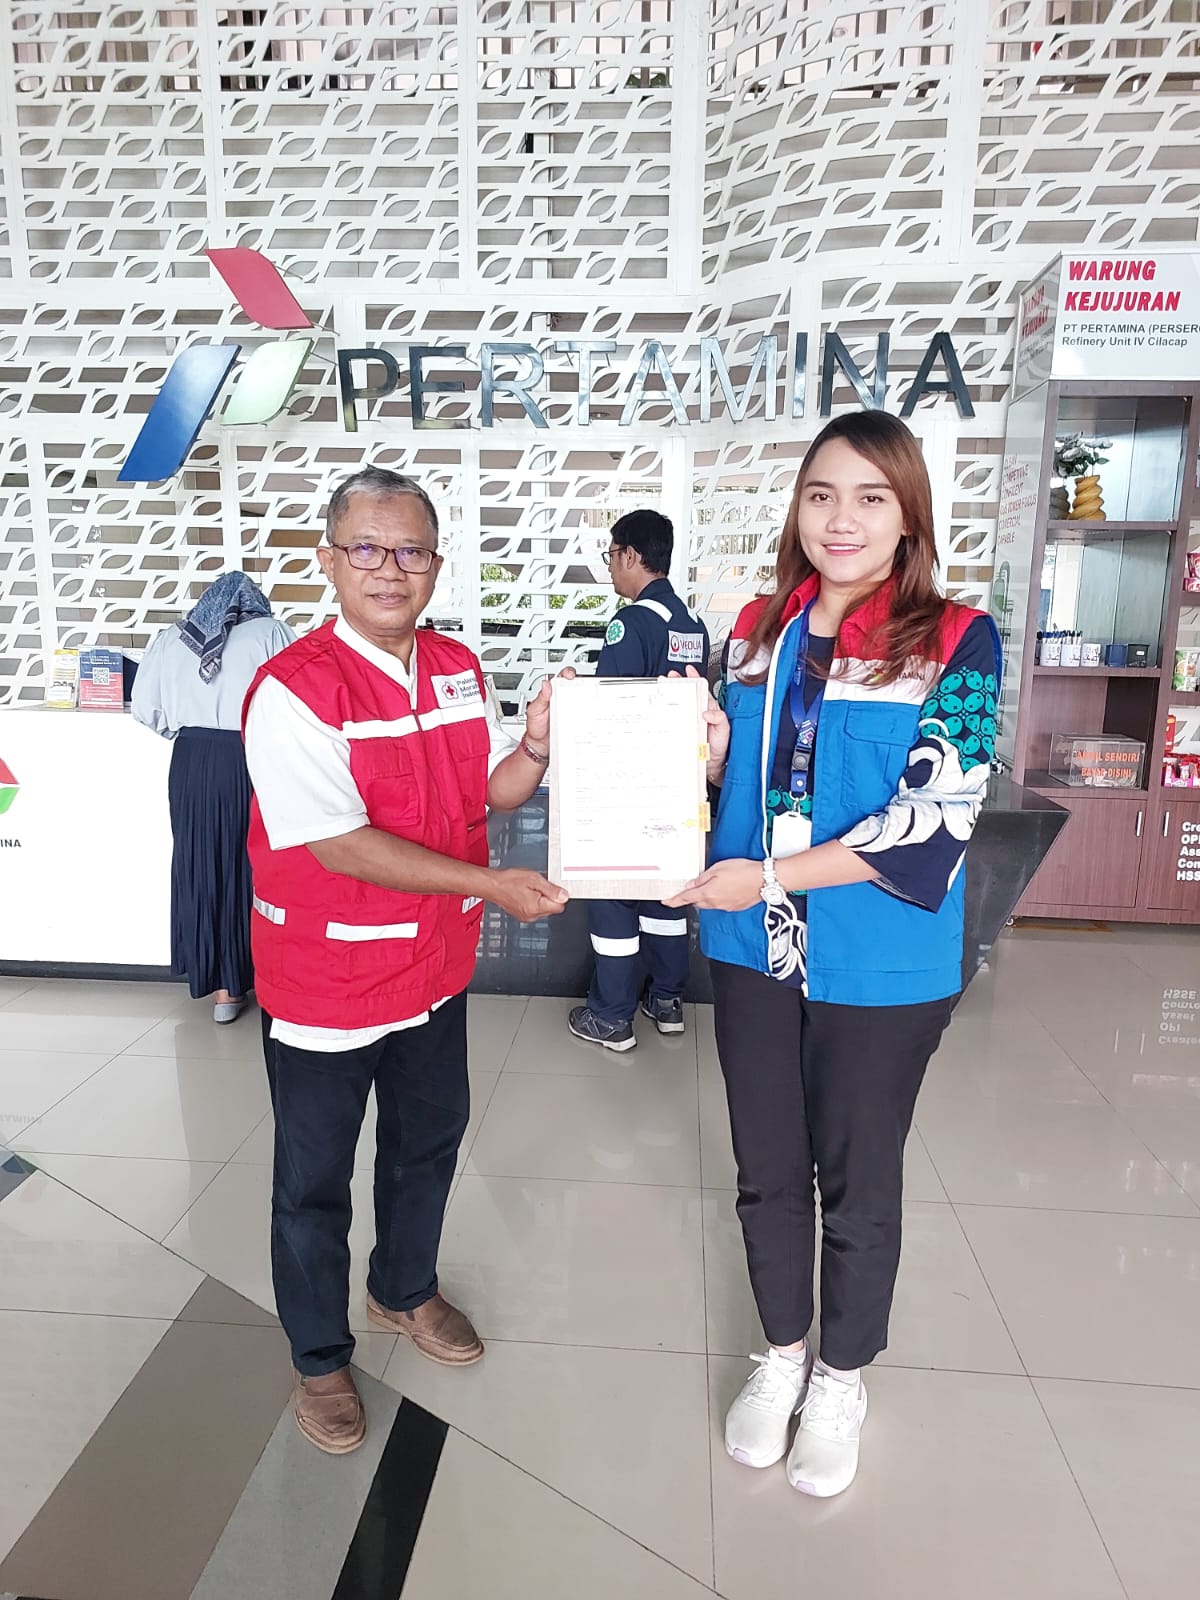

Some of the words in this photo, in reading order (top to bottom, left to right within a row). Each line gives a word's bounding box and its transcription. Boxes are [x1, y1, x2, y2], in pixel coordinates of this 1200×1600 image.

[1068, 260, 1157, 281] WARUNG
[1064, 291, 1181, 311] KEJUJURAN
[1063, 324, 1078, 333] PT
[1080, 324, 1146, 333] PERTAMINA
[1148, 323, 1200, 335] (PERSER
[1062, 336, 1106, 348] Refinery
[1109, 336, 1131, 346] Unit
[1134, 336, 1145, 346] IV
[1147, 336, 1188, 348] Cilacap
[337, 332, 976, 432] PERTAMINA
[1105, 752, 1140, 762] SENDIRI
